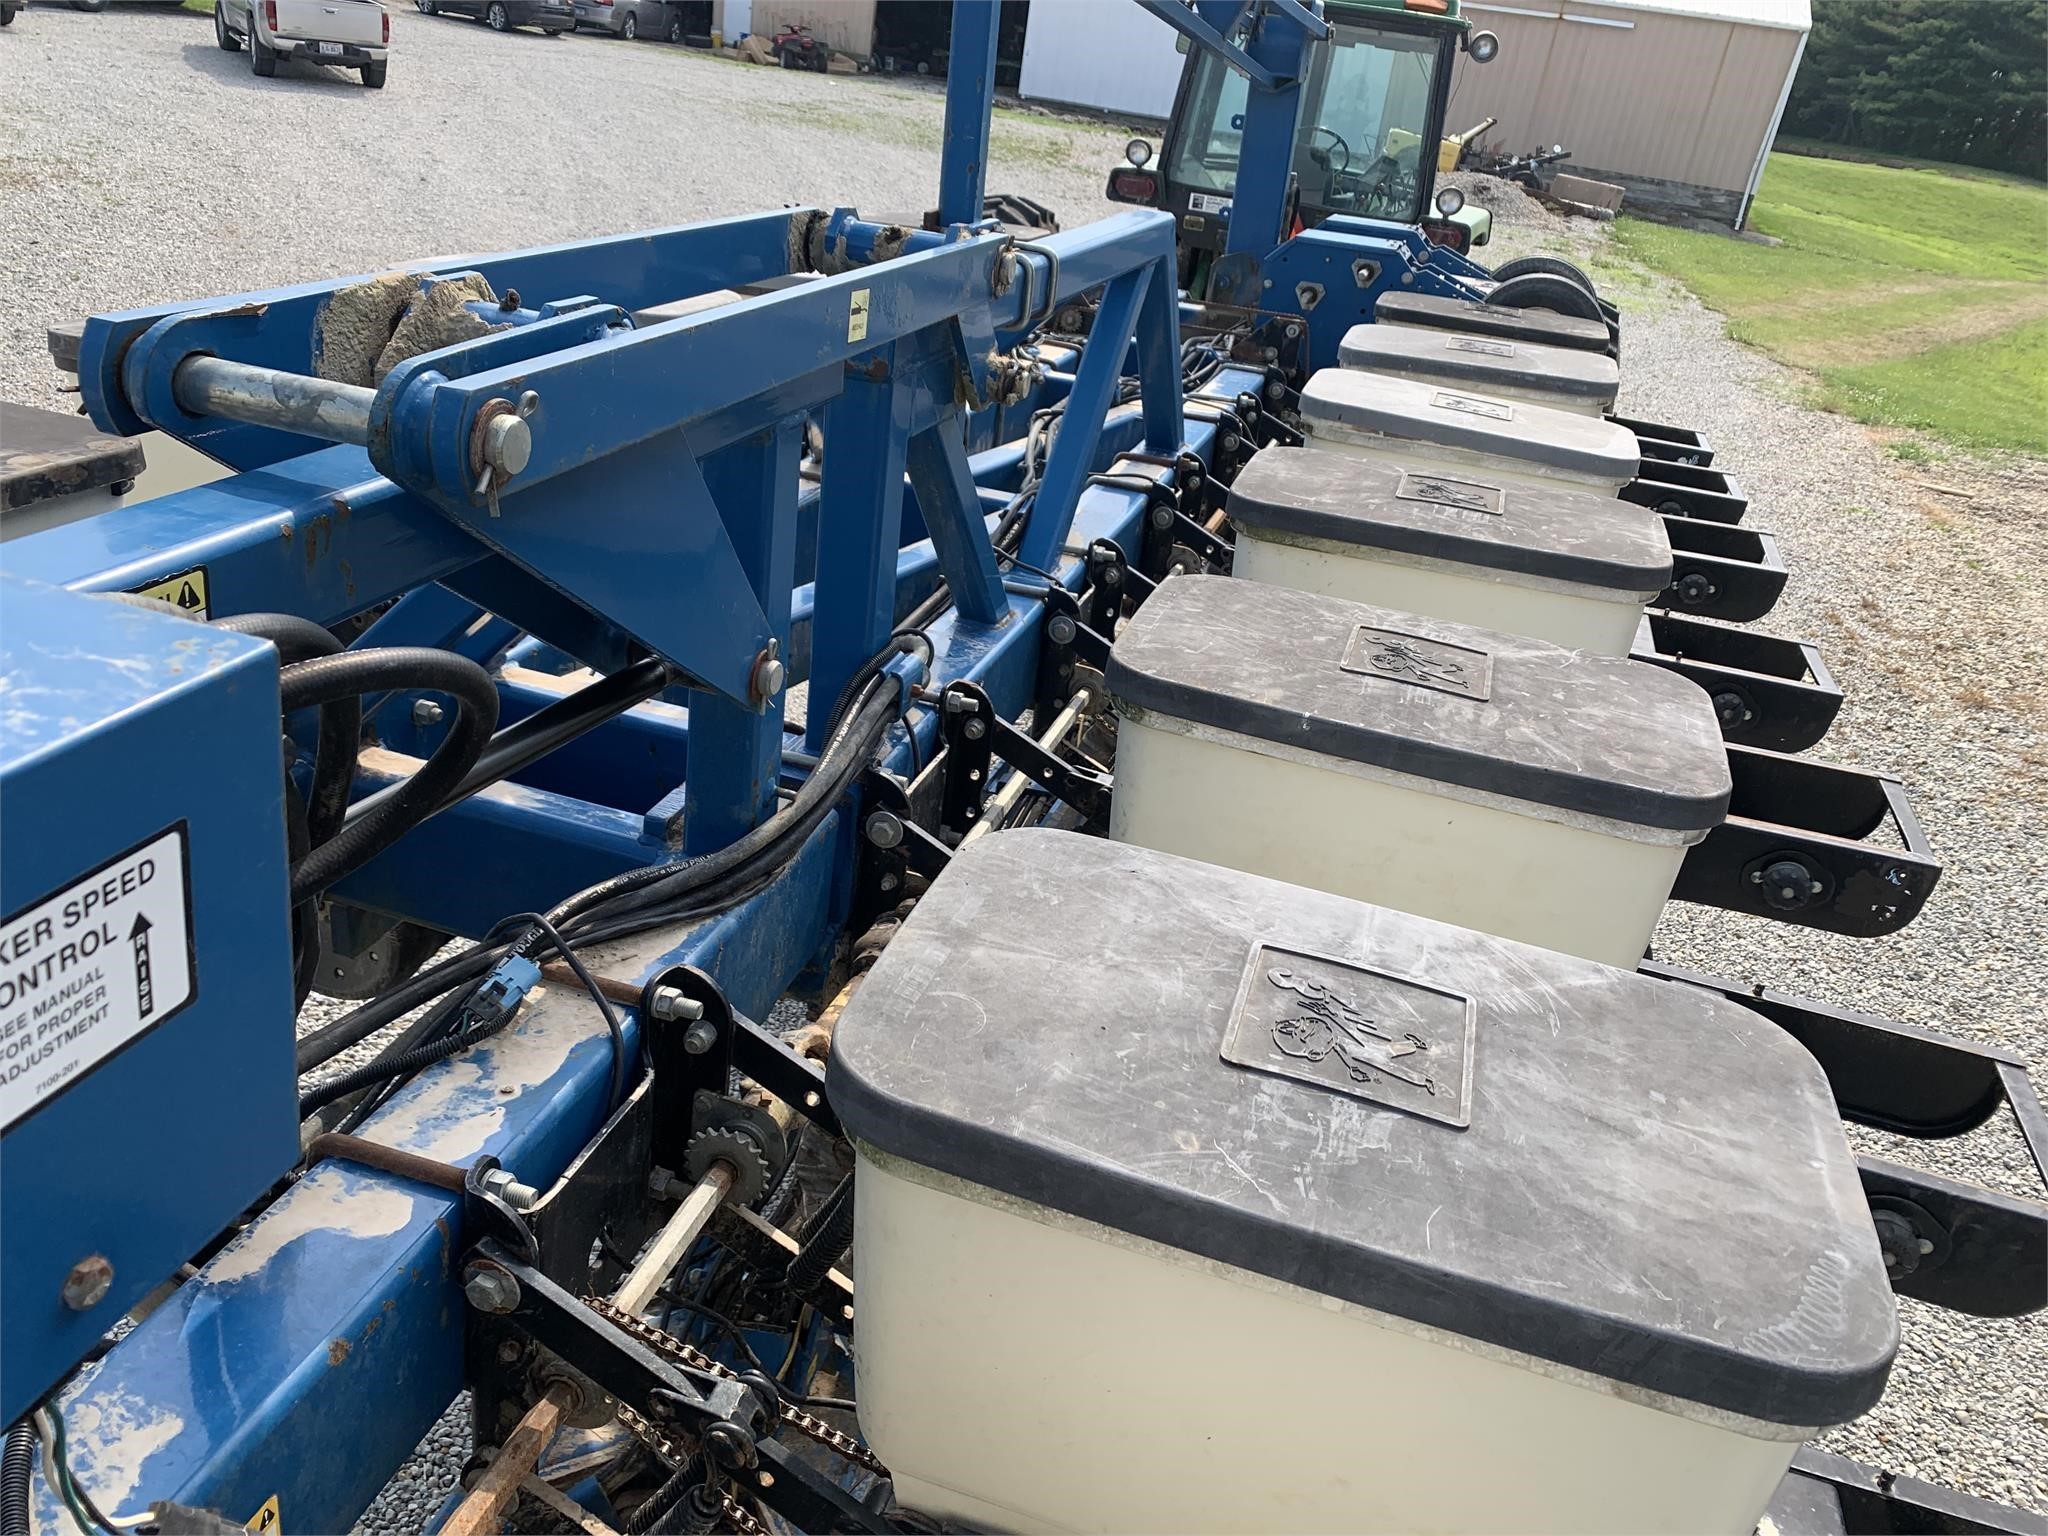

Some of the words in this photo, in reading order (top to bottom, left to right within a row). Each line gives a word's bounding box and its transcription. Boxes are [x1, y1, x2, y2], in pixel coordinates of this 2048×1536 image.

[62, 859, 155, 928] SPEED
[0, 922, 118, 1010] ONTROL
[33, 967, 104, 1020] MANUAL
[136, 931, 152, 1011] RAISE
[0, 1002, 110, 1087] ADJUSTMENT
[37, 985, 107, 1041] PROPER
[35, 1059, 79, 1095] 7100-201
